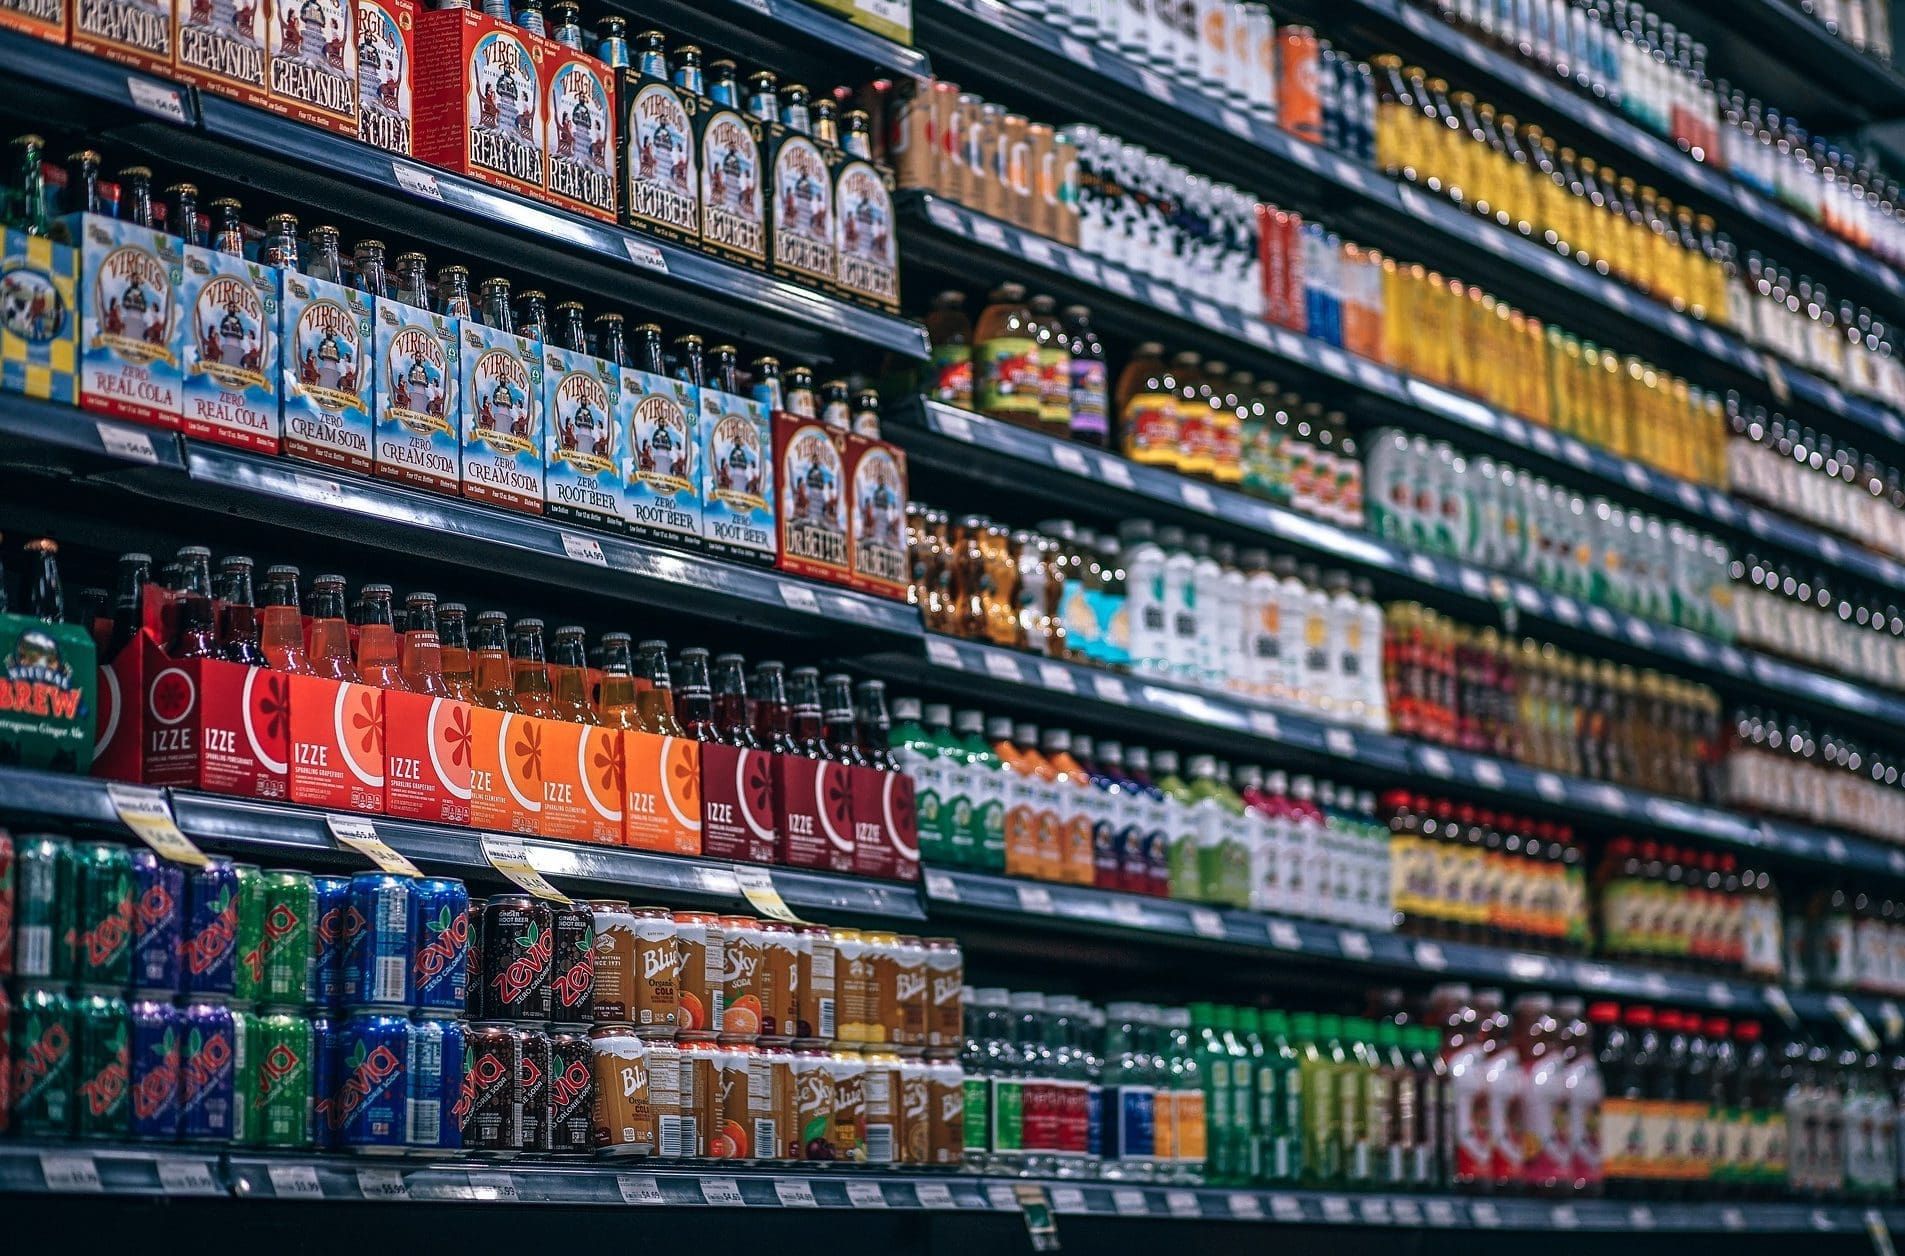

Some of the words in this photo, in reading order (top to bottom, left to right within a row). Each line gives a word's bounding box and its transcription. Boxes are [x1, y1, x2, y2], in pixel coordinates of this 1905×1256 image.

[470, 129, 507, 172] REAL
[396, 331, 443, 370] VIRGIL'S
[480, 353, 527, 392] VIRGIL'S
[95, 371, 136, 395] REAL
[138, 382, 173, 406] COLA
[219, 391, 245, 408] ZERO
[194, 398, 233, 422] REAL
[235, 407, 269, 430] COLA
[319, 412, 343, 429] ZERO
[291, 417, 337, 444] CREAM
[338, 429, 368, 452] SODA
[409, 436, 432, 452] ZERO
[382, 442, 425, 468] CREAM
[426, 453, 454, 474] SODA
[494, 456, 516, 471] ZERO
[468, 461, 510, 486] CREAM
[510, 472, 538, 493] SODA
[577, 476, 598, 490] ZERO
[555, 484, 587, 503] ROOT
[587, 490, 619, 514] BEER
[655, 496, 676, 511] ZERO
[633, 504, 664, 523] ROOT
[664, 509, 696, 532] BEER
[153, 728, 192, 751] IZZE
[205, 728, 236, 753] IZZE
[295, 743, 328, 766] IZZE
[391, 756, 421, 780] IZZE
[471, 770, 491, 792] ZZE
[544, 781, 572, 803] IZZE
[630, 792, 655, 813] IZZE
[708, 802, 733, 823] IZZE
[789, 813, 814, 835] IZZE
[655, 987, 674, 996] COLA
[490, 1076, 507, 1094] SODA
[528, 1081, 543, 1098] SODA
[556, 1100, 580, 1124] CALORIE
[579, 1083, 592, 1101] SODA
